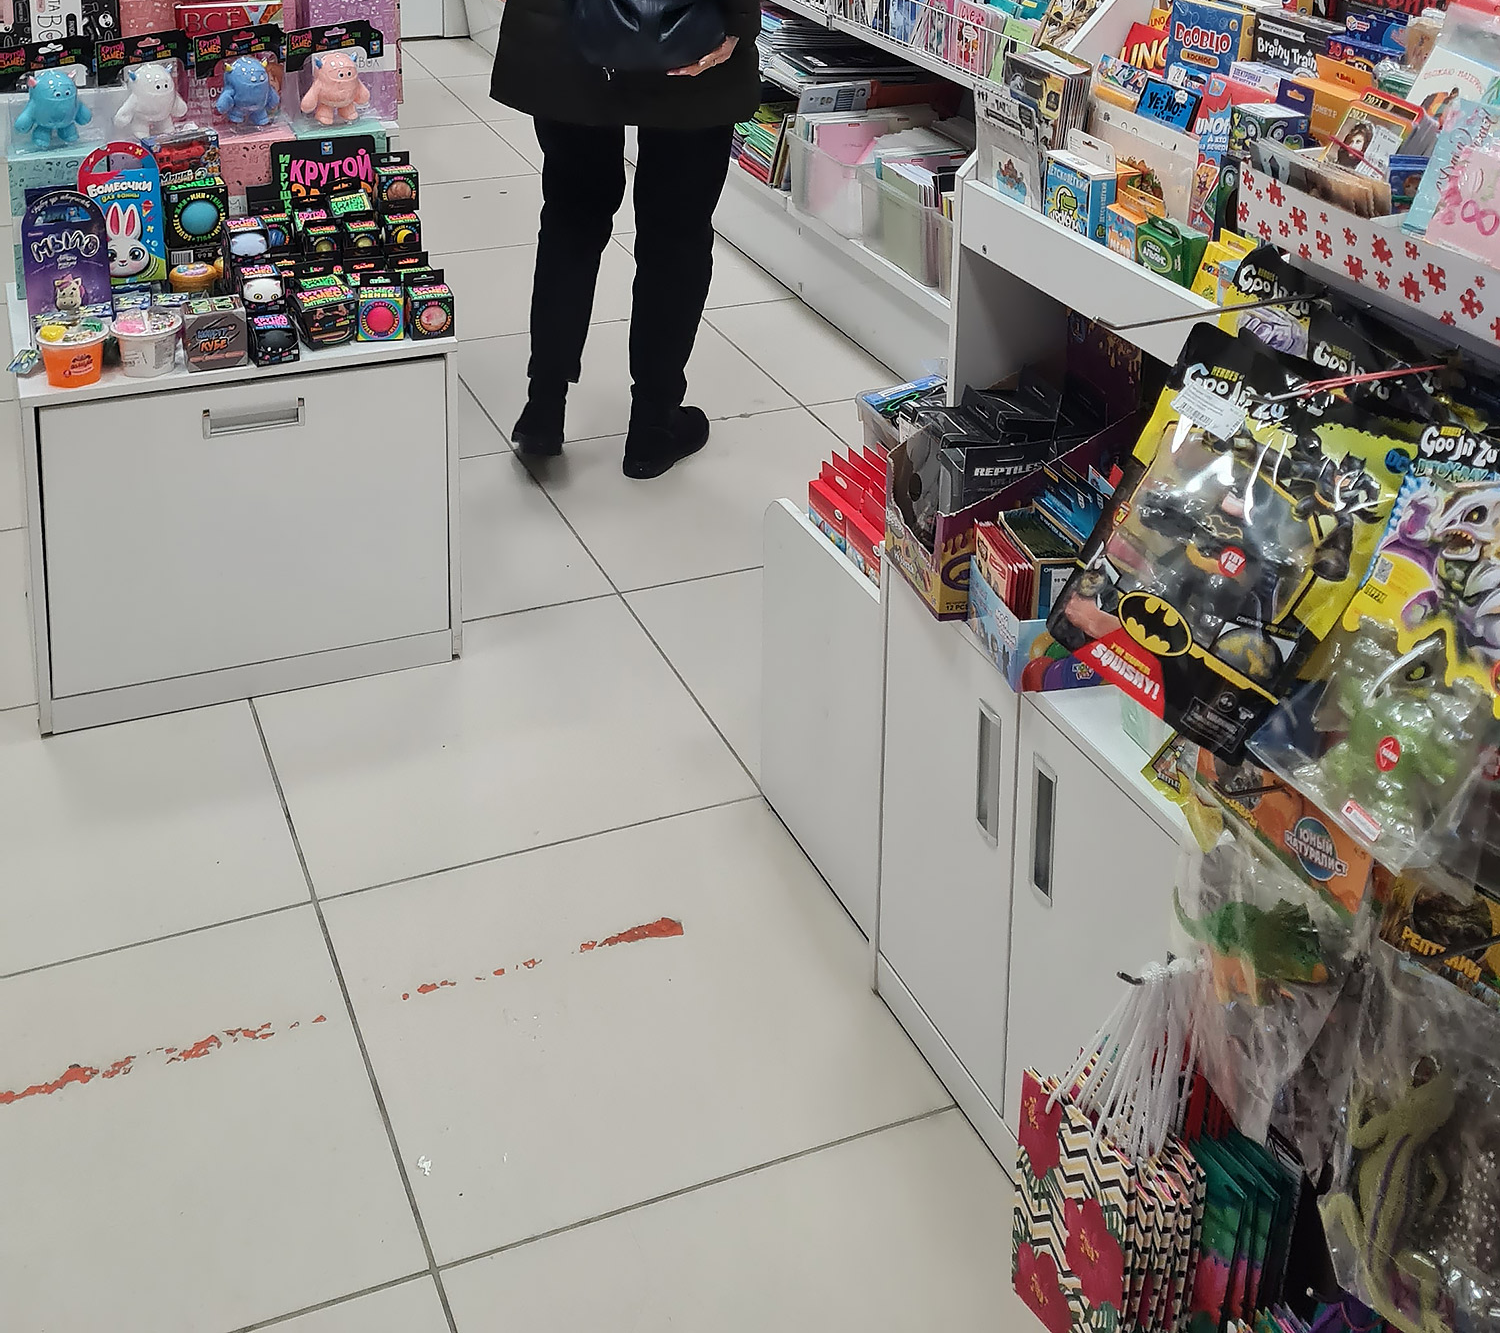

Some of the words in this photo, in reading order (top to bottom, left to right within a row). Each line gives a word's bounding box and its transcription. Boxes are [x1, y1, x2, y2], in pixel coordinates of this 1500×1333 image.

[184, 8, 242, 32] ВСЁ
[1150, 15, 1166, 27] UNO
[1175, 22, 1232, 54] DOOBLIO
[1257, 37, 1290, 67] Brainy
[290, 148, 374, 187] КРУТОЙ
[87, 179, 154, 198] БОМБОЧКИ
[30, 229, 100, 264] МЫЛО
[200, 336, 228, 351] КУБЕ
[1211, 365, 1239, 382] HEROES
[1420, 425, 1456, 458] Goo
[1448, 434, 1478, 461] Jit
[1473, 440, 1500, 468] Zu
[945, 603, 954, 613] 12
[1090, 643, 1162, 701] SQUISHY!
[1284, 829, 1349, 877] НАТУРАЛИСТ
[1298, 826, 1334, 856] ЮНЫЙ
